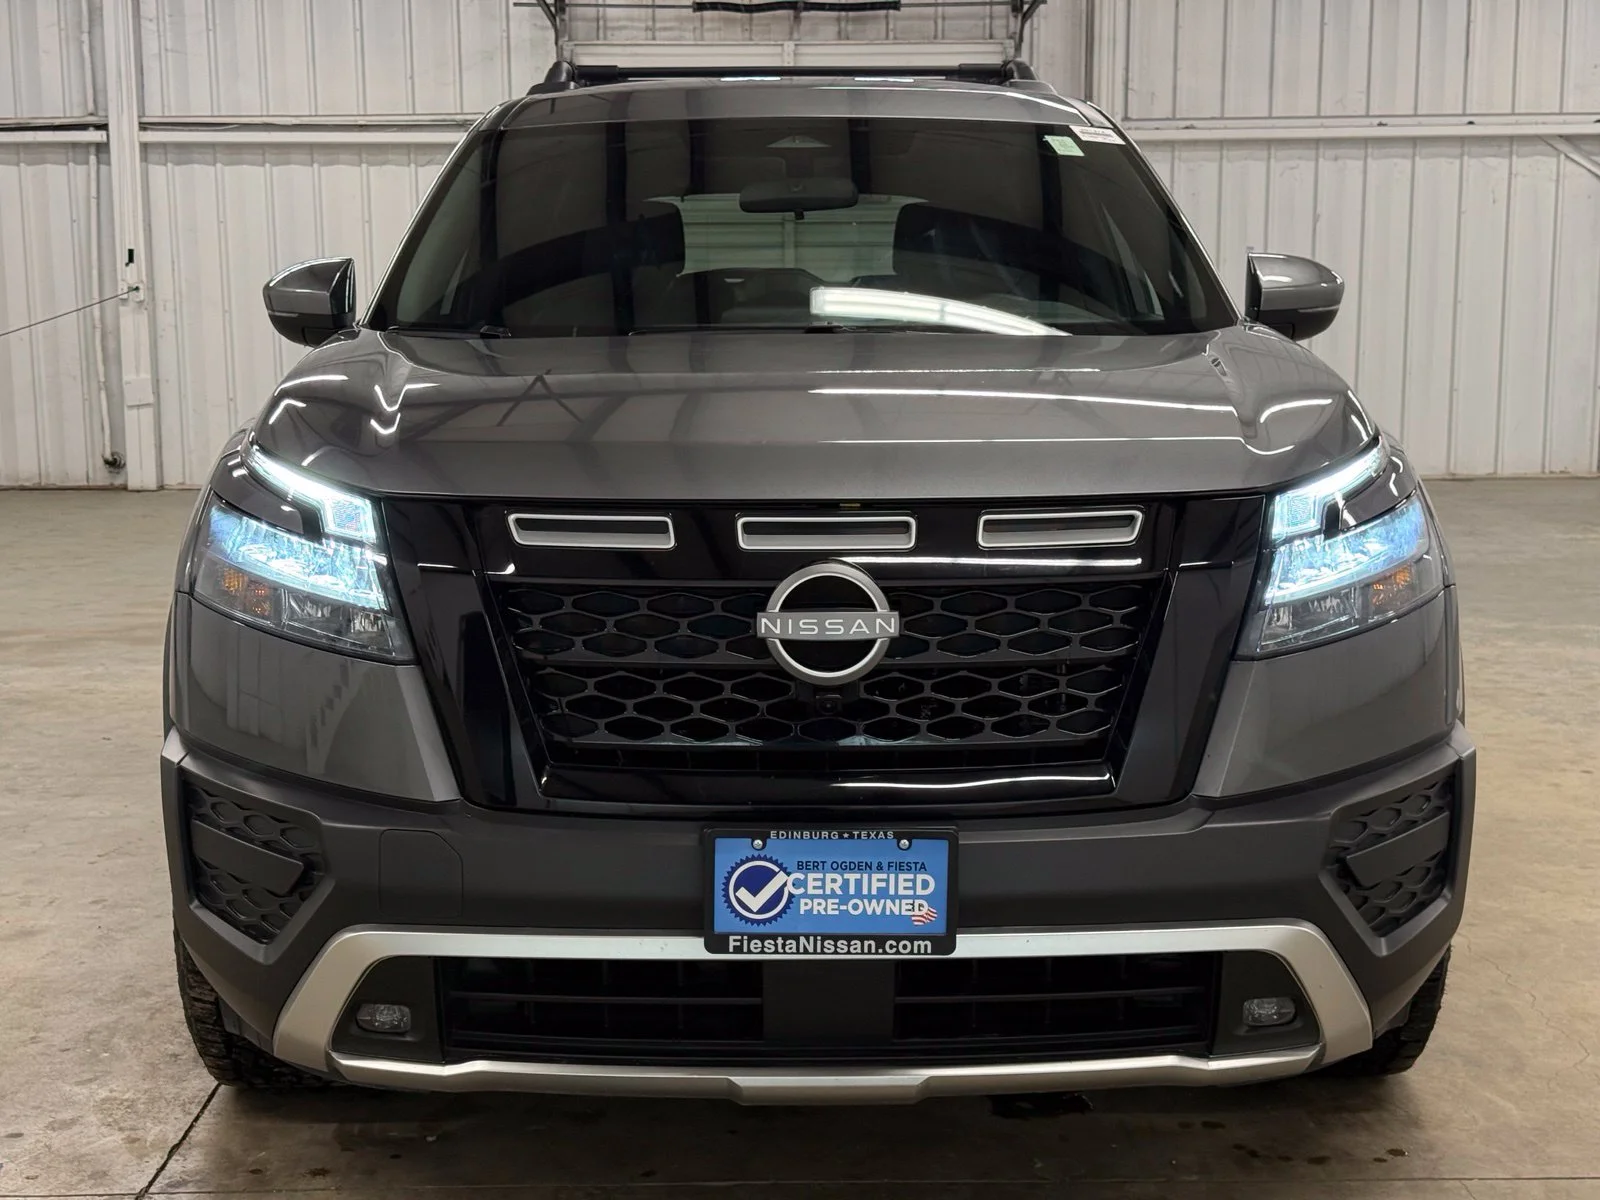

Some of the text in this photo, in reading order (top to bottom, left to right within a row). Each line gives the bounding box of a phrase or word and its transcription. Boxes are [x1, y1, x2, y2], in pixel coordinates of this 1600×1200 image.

[760, 617, 896, 636] NISSAN
[770, 830, 895, 840] EDINBURG TEXAS
[796, 860, 928, 872] BERT OGDEN & FIESTA
[786, 872, 936, 896] CERTIFIED
[799, 899, 930, 916] PRE-OWNED
[728, 935, 932, 954] FiestaNissan.com
